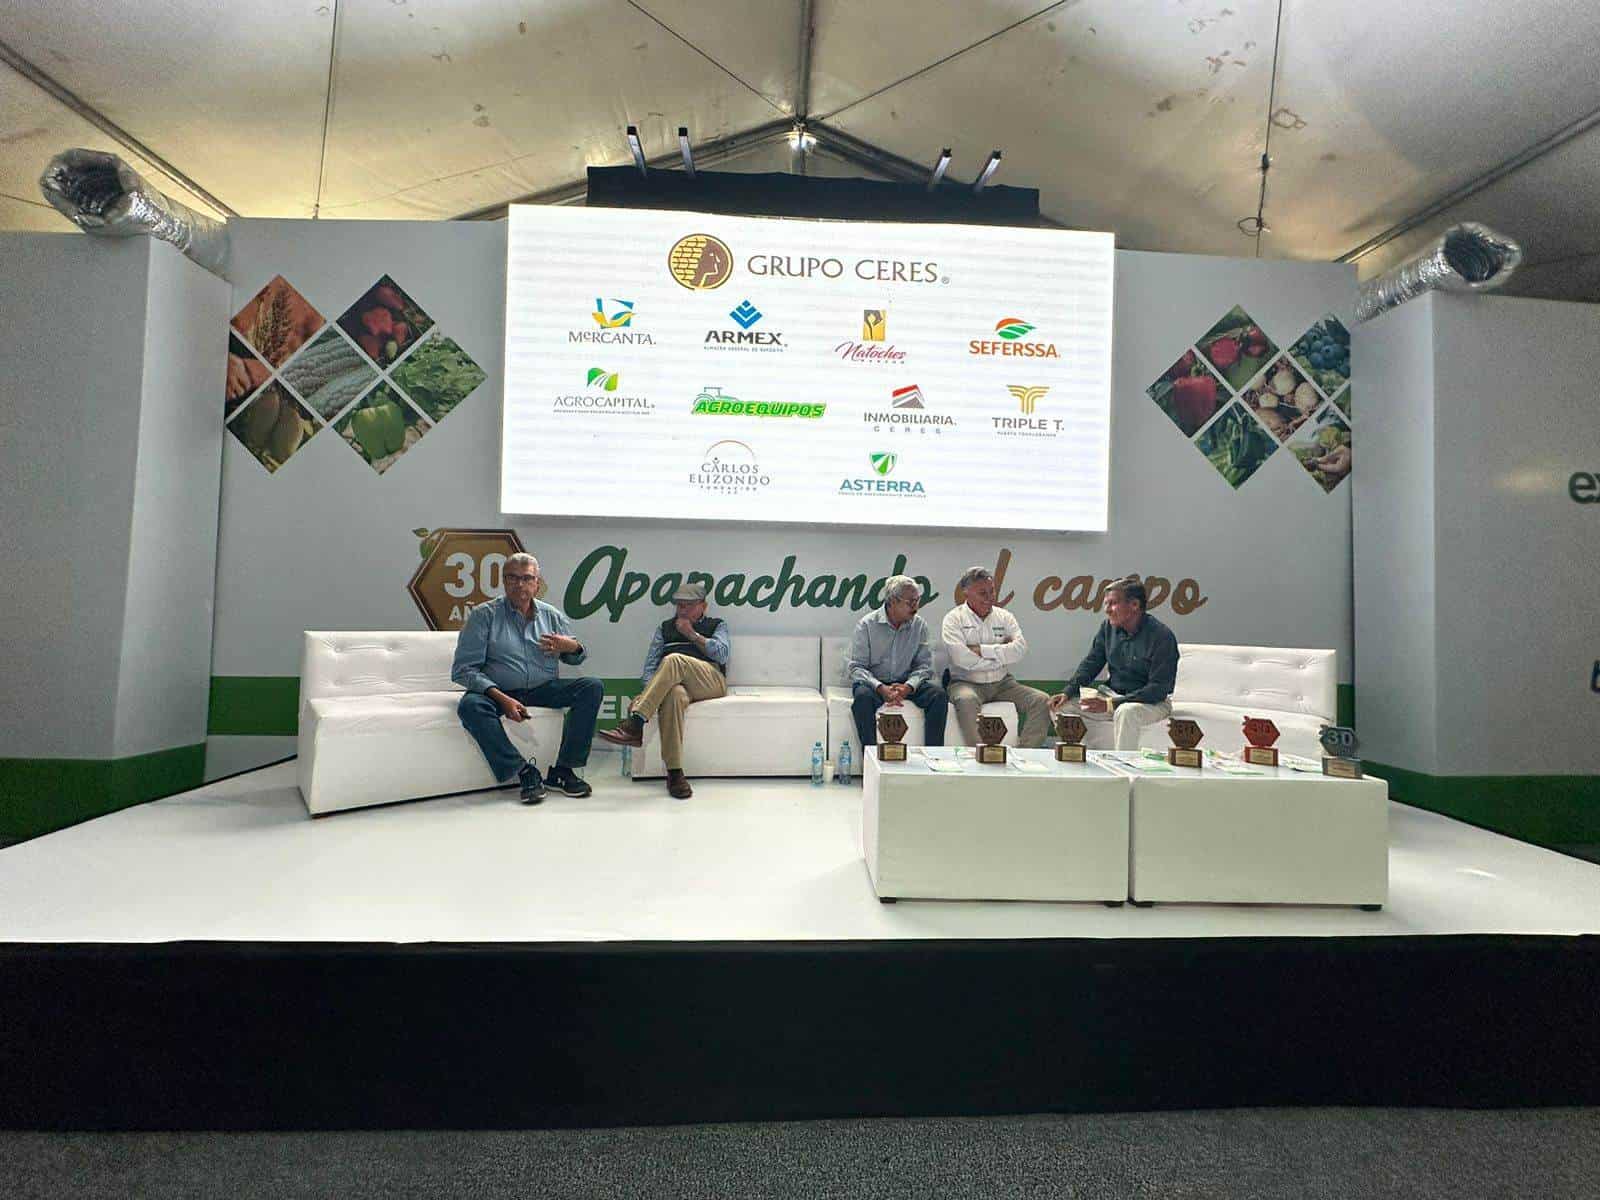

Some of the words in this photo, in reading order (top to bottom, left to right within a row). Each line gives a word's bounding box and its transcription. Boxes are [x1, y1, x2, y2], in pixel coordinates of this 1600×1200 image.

[747, 254, 844, 279] GRUPO
[854, 259, 938, 284] CERES
[704, 329, 783, 347] ARMEX
[968, 339, 1057, 359] SEFERSSA
[553, 396, 650, 410] AGROCAPITAL
[693, 399, 827, 419] AGROEQUIPOS
[863, 411, 953, 427] INMOBILIARIA
[991, 416, 1048, 431] TRIPLE
[701, 459, 760, 475] CARLOS
[688, 473, 771, 487] ELIZONDO
[839, 478, 926, 494] ASTERRA
[443, 551, 507, 598] 30
[954, 548, 1015, 606] l
[1032, 574, 1208, 616] capo
